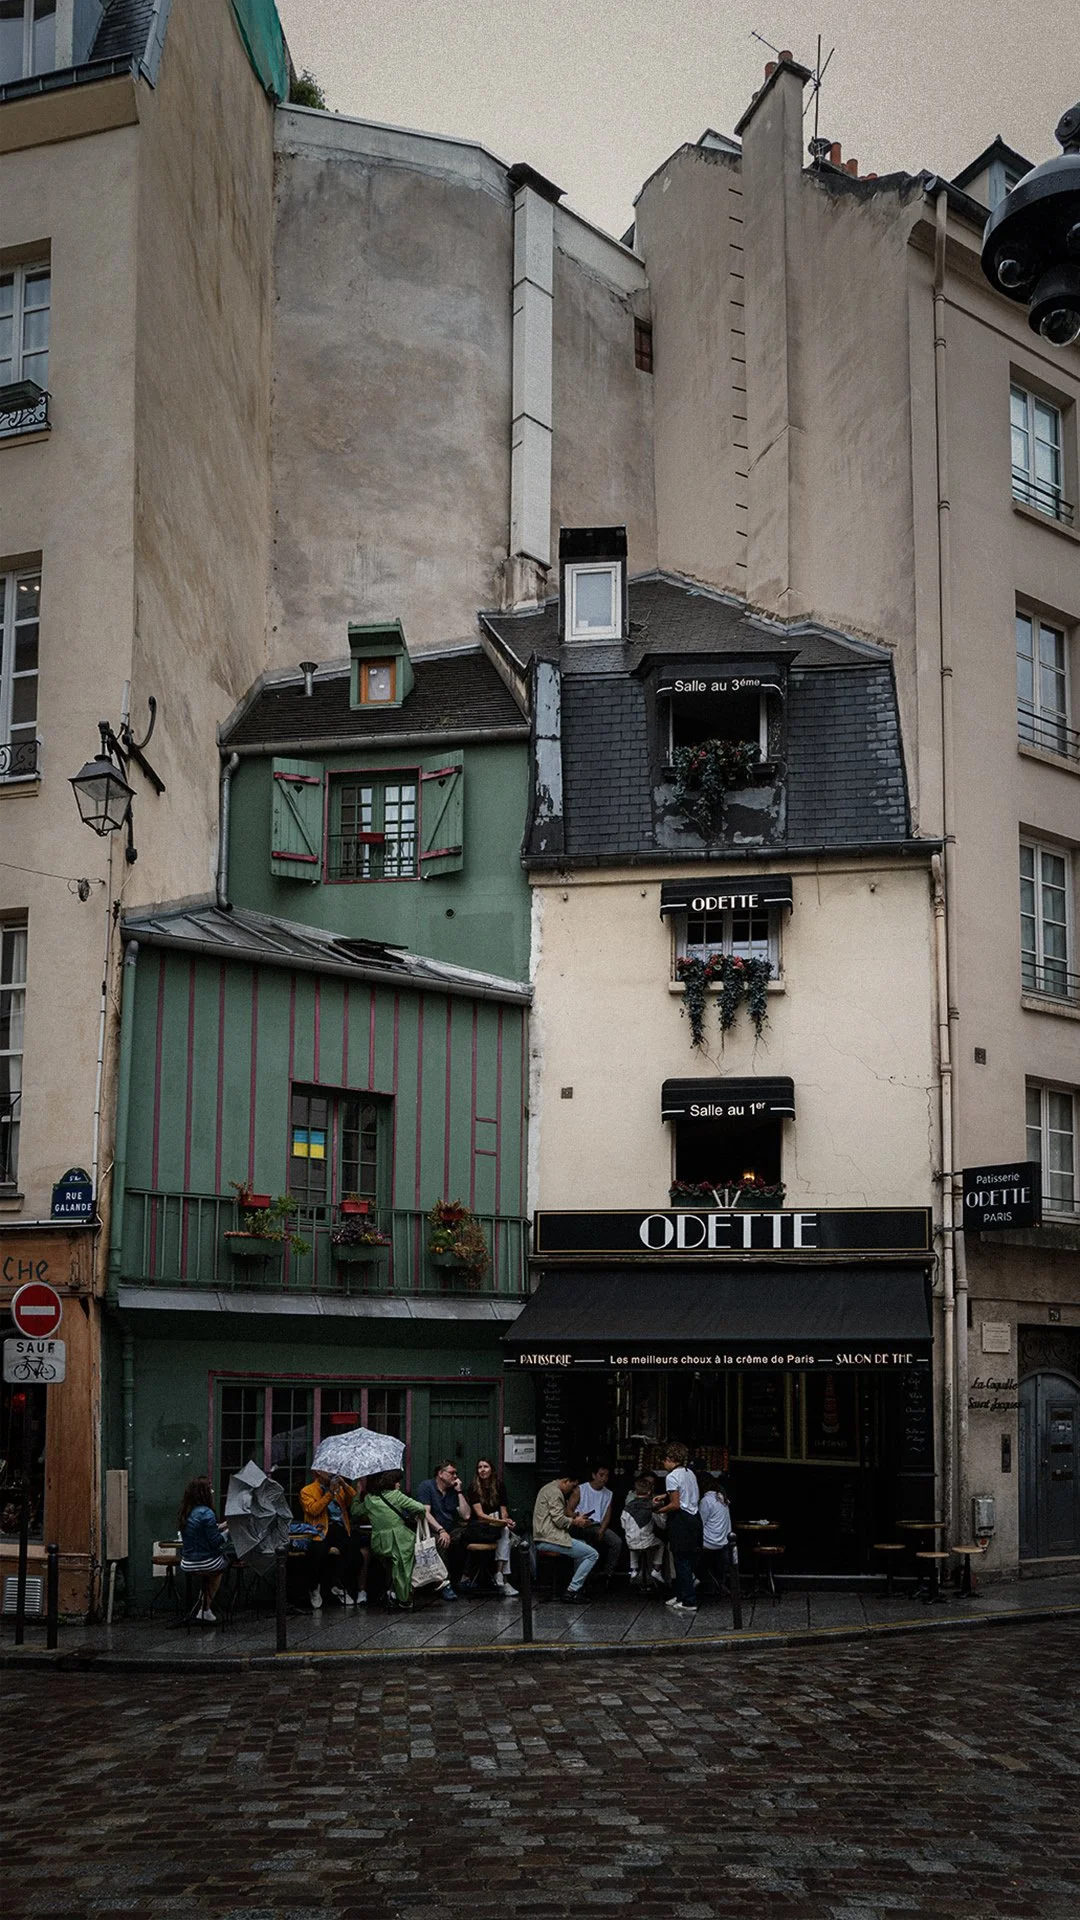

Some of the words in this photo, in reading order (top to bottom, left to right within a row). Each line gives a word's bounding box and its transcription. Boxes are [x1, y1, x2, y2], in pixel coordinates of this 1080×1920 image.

[674, 680, 707, 692] Salle
[710, 682, 728, 692] au
[691, 894, 759, 912] ODETTE
[689, 1104, 724, 1117] Salle
[727, 1106, 745, 1116] au
[749, 1102, 766, 1115] 1er
[976, 1171, 1020, 1185] Patisserie
[65, 1191, 83, 1201] RUE
[965, 1186, 1031, 1208] ODETTE
[54, 1202, 92, 1212] GALANDE
[983, 1211, 1013, 1223] PARIS
[639, 1213, 817, 1250] ODETTE
[16, 1342, 56, 1353] SAUF
[520, 1354, 572, 1367] PATISSERIE
[610, 1355, 629, 1364] Les
[631, 1355, 679, 1364] meilleurs
[680, 1355, 712, 1364] choux
[714, 1355, 721, 1364] à
[723, 1355, 733, 1364] la
[770, 1355, 784, 1364] de
[786, 1355, 815, 1364] Paris
[835, 1353, 872, 1366] SALON
[874, 1353, 889, 1364] DE
[971, 1377, 984, 1389] La
